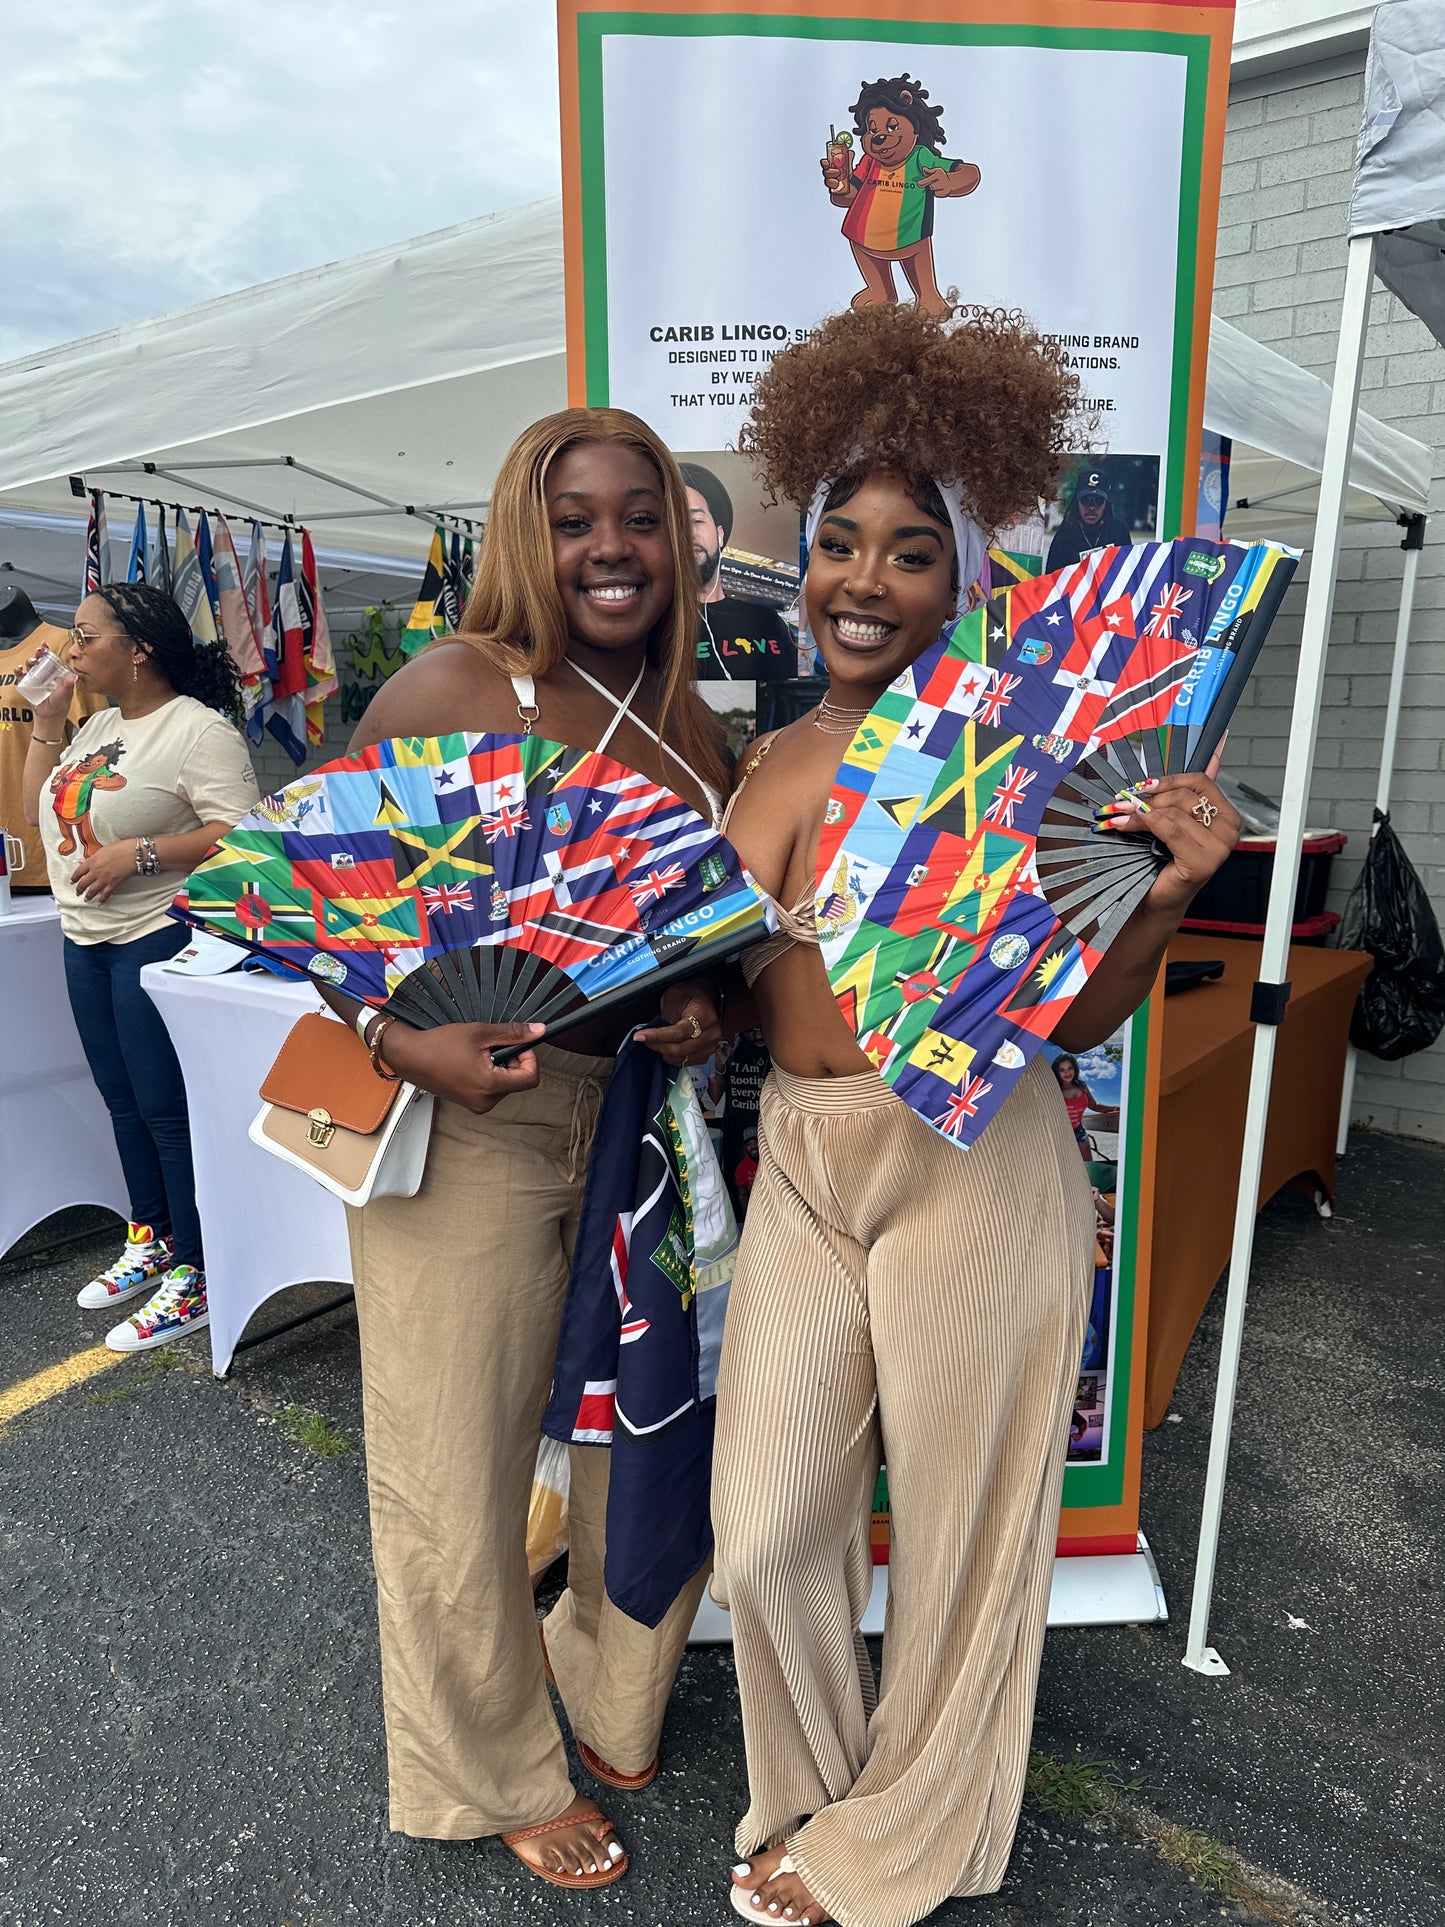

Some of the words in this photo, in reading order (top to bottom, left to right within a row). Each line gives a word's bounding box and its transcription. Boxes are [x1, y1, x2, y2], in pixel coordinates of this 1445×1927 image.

[650, 326, 714, 342] CARIB
[1094, 336, 1139, 348] BRAND
[668, 350, 737, 364] DESIGNED
[740, 350, 757, 362] TO
[711, 372, 729, 384] BY
[671, 394, 705, 406] THAT
[709, 393, 735, 406] YOU
[1229, 618, 1243, 642] BRAND
[1175, 648, 1213, 706] CARIB
[1204, 584, 1244, 642] LINGO
[587, 934, 648, 968] CARIB
[653, 905, 715, 942] LINGO
[626, 946, 662, 965] CLOTHING
[662, 937, 687, 951] BRAND
[742, 1064, 759, 1073] Am
[730, 1075, 763, 1086] Rootin
